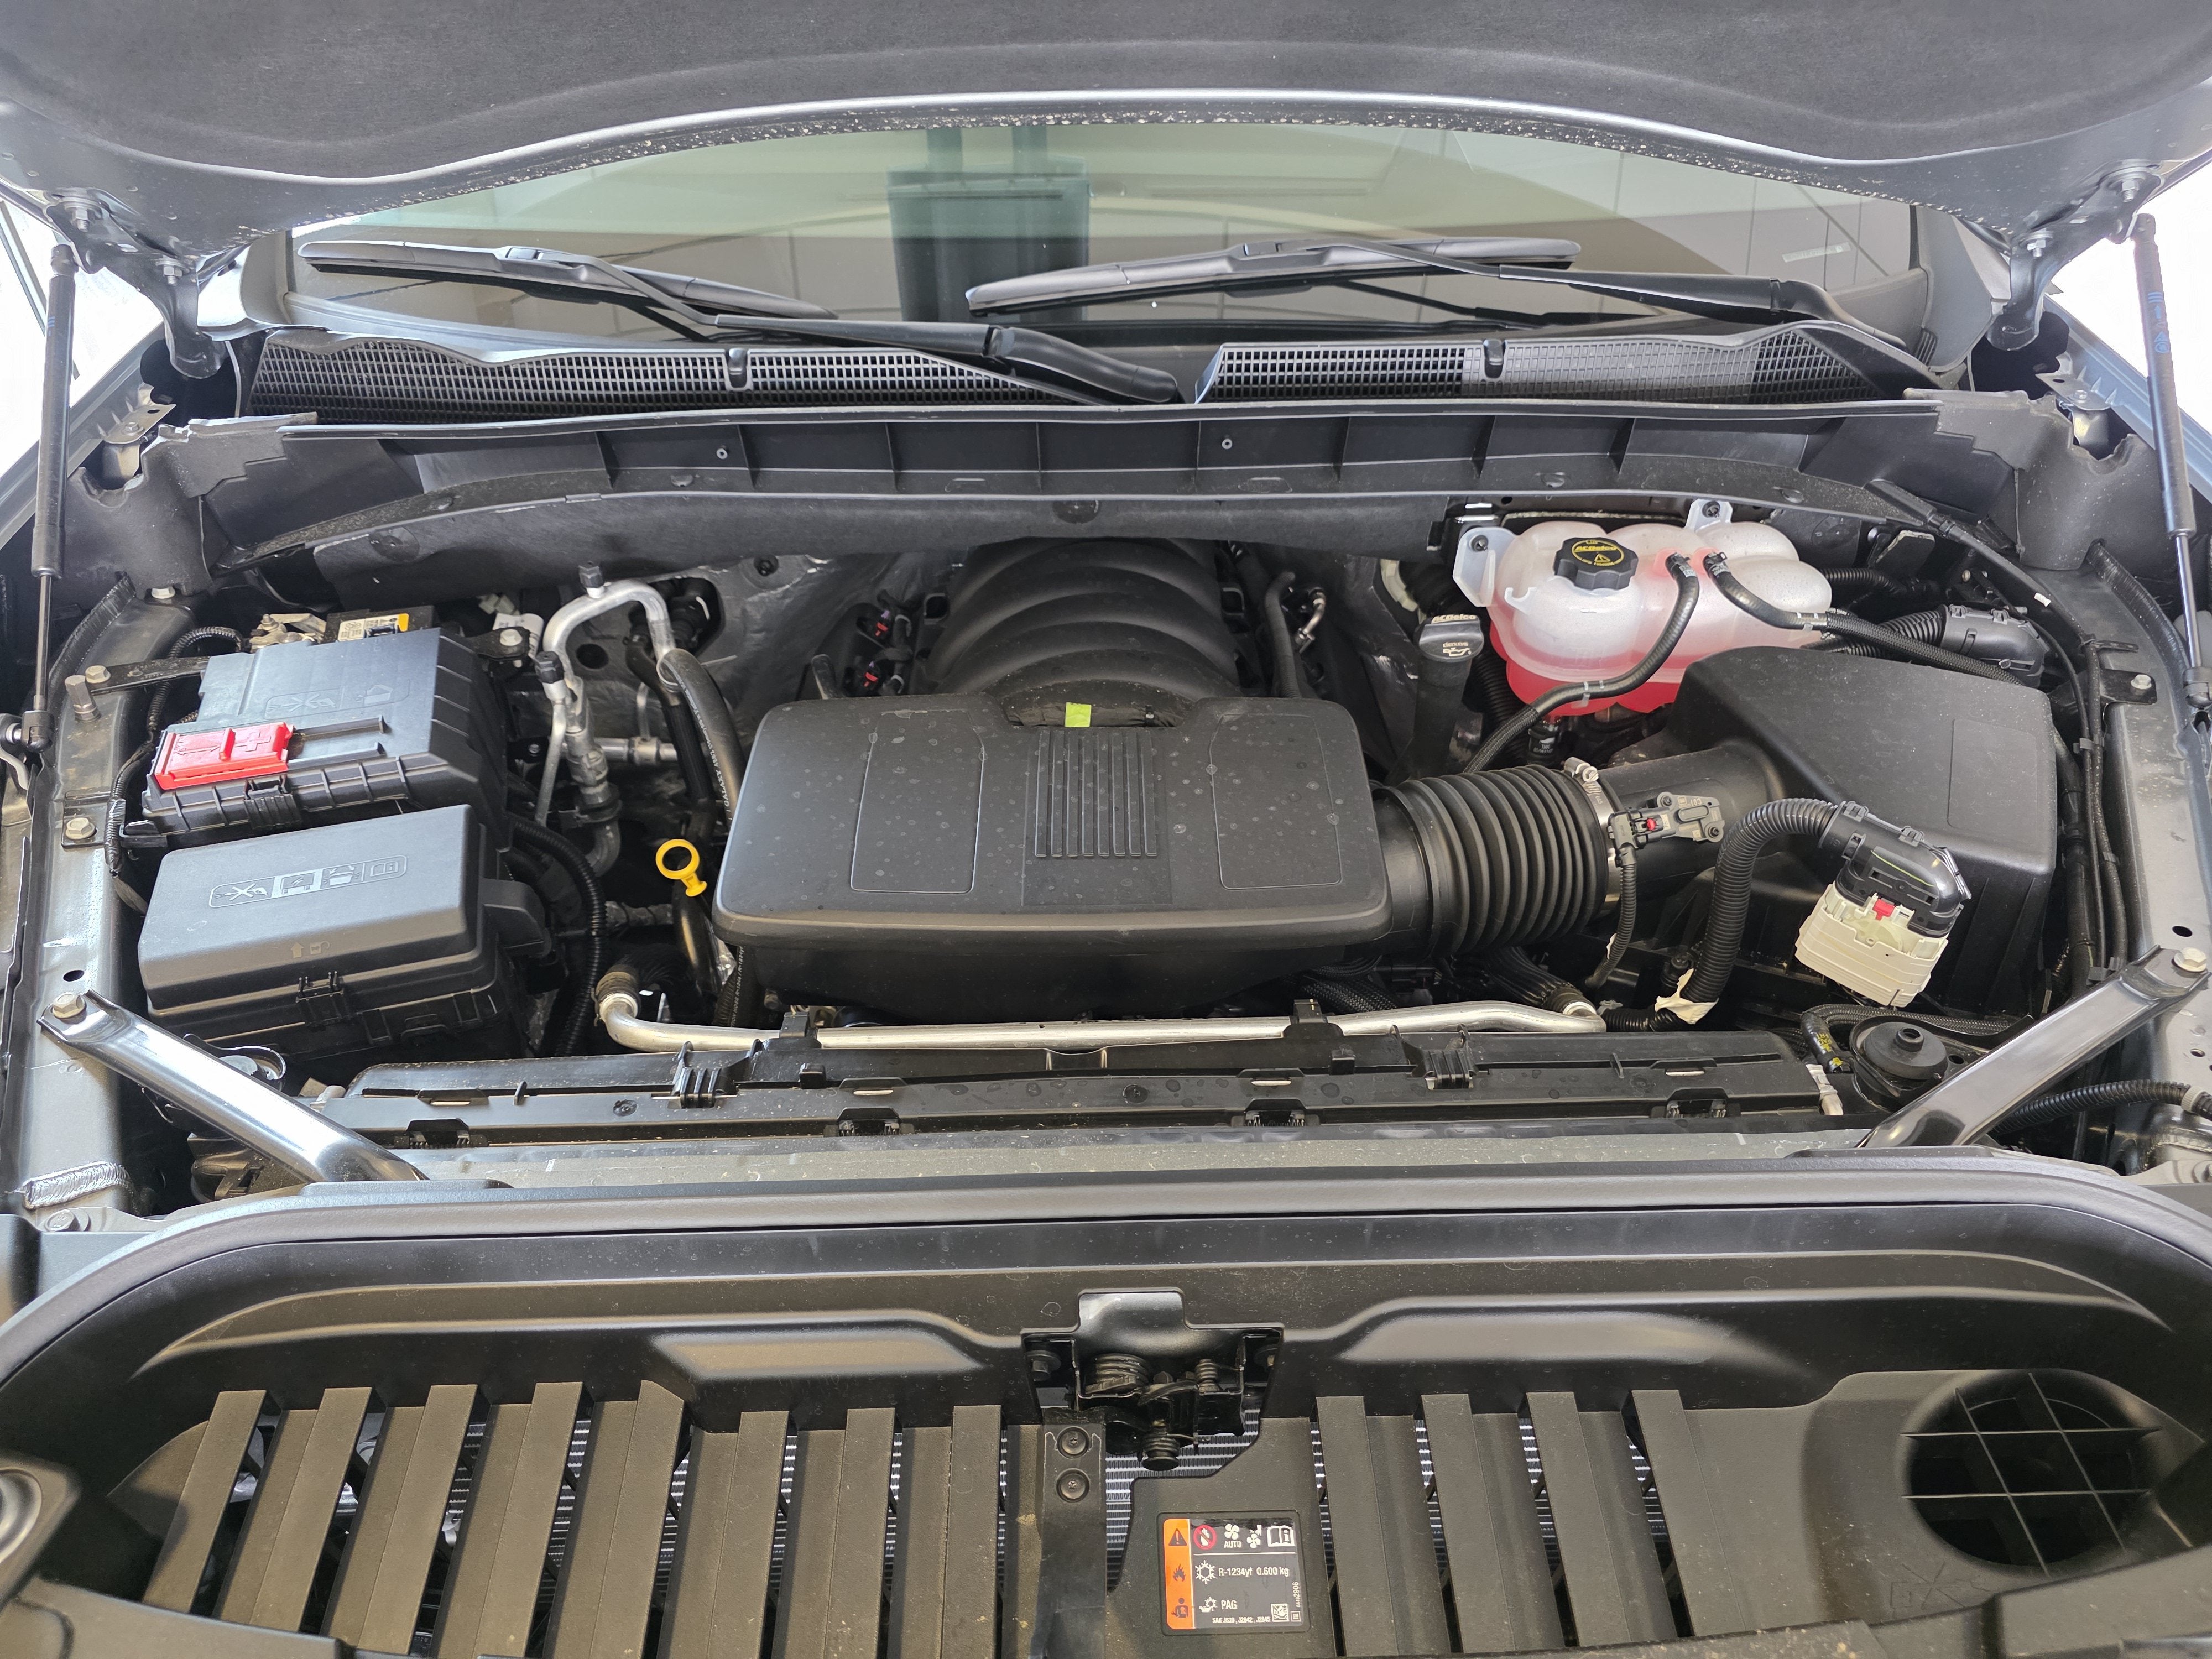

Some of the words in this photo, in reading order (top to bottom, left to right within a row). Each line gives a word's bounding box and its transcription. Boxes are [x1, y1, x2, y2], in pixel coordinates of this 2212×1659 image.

[1431, 614, 1477, 624] ACDelco
[716, 770, 729, 807] GALAXY
[1218, 1567, 1253, 1577] R-1234yf
[1256, 1567, 1277, 1575] 0.600
[1279, 1567, 1290, 1577] kg
[1221, 1600, 1238, 1610] PAG
